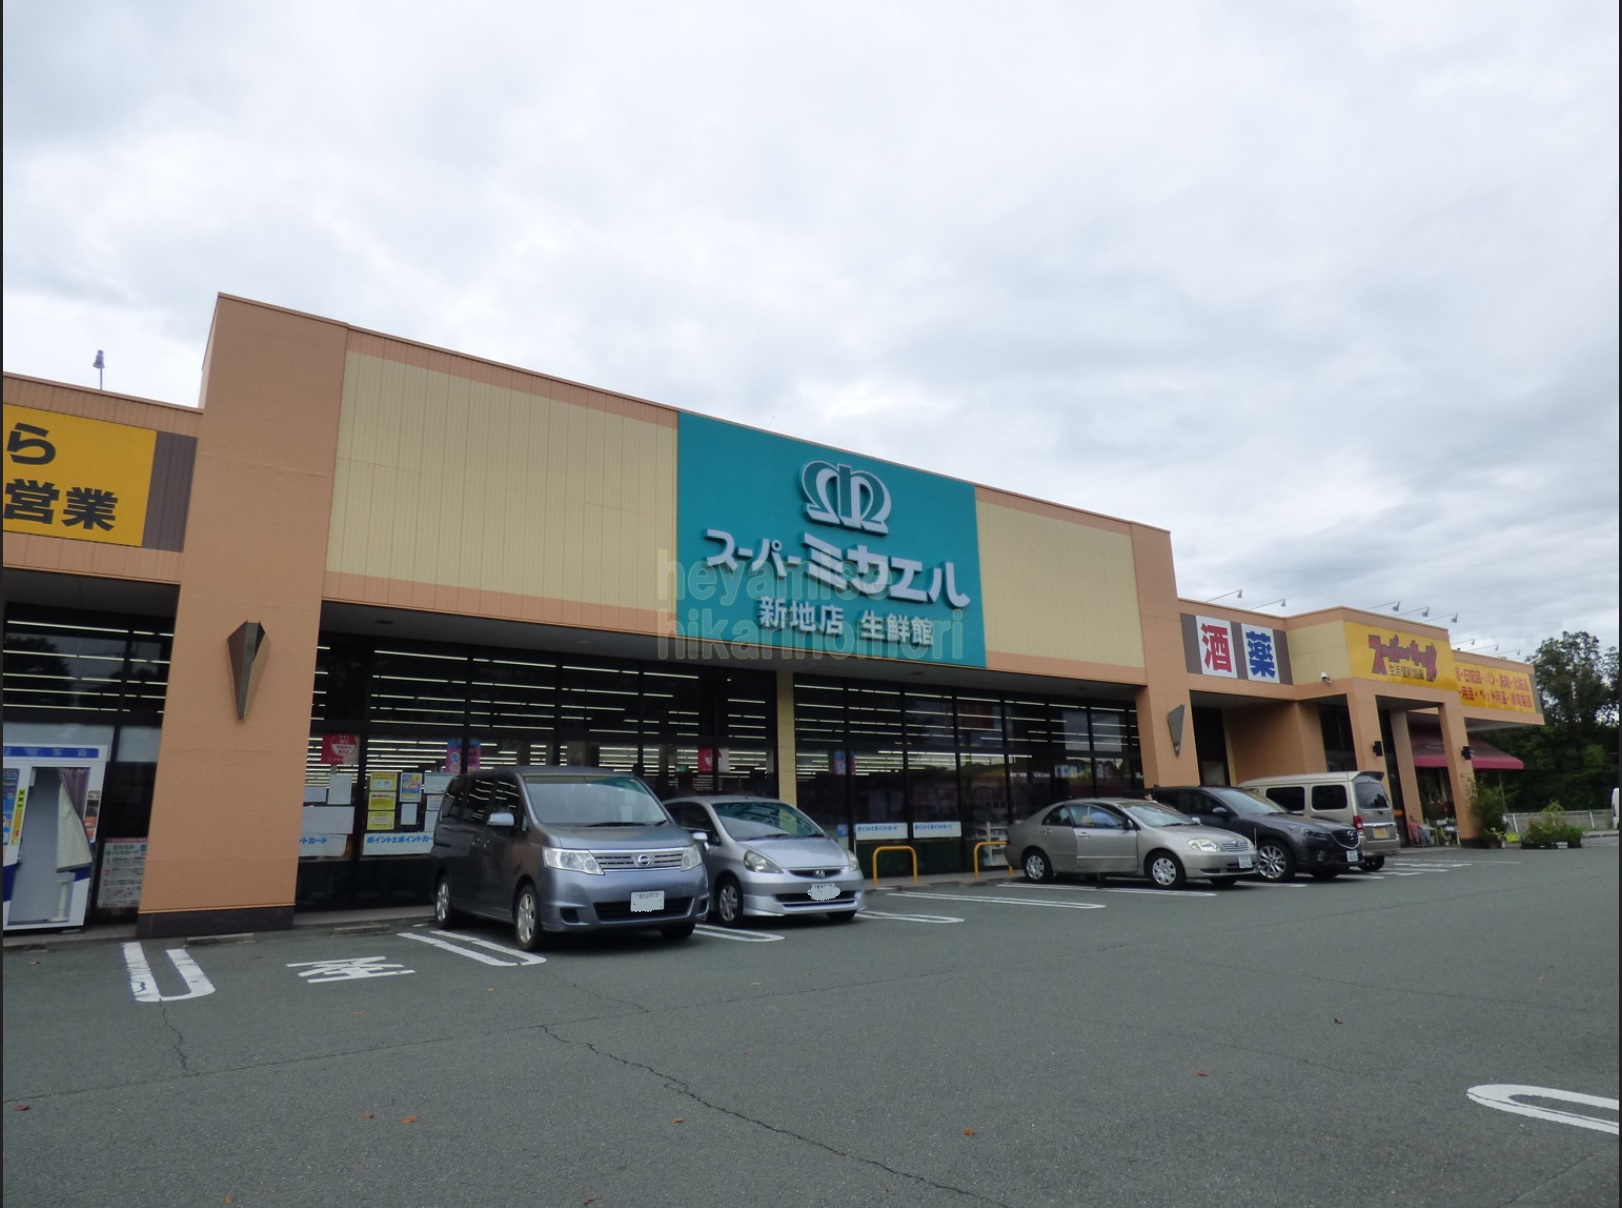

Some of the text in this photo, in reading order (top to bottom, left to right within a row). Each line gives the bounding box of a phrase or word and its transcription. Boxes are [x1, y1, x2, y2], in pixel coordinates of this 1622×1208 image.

[6, 422, 57, 466] ら
[3, 478, 119, 532] 営業
[759, 596, 935, 647] 新地店 生鮮館
[1200, 622, 1233, 673] 酒
[1245, 630, 1277, 679] 薬
